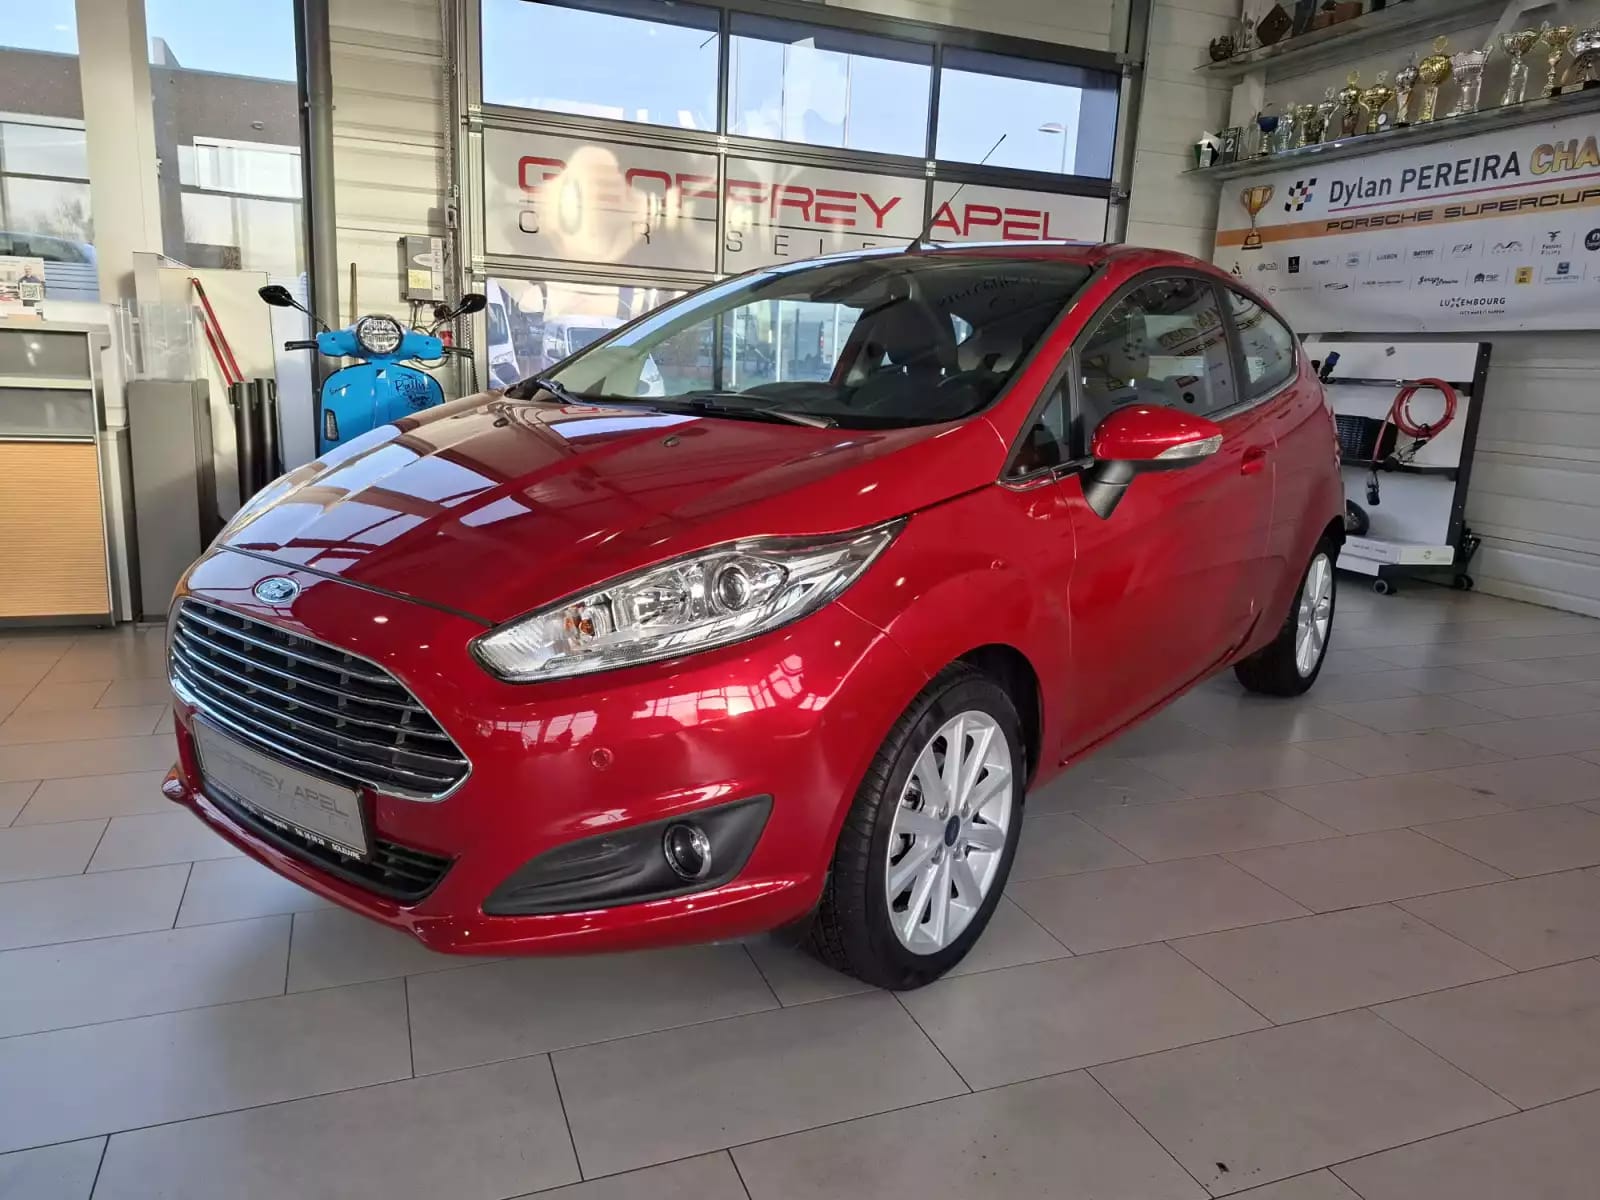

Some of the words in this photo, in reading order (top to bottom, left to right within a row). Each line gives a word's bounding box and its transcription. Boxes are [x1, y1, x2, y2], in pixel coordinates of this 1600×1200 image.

[1328, 174, 1392, 207] Dylan
[1400, 150, 1521, 194] PEREIRA
[1529, 134, 1600, 176] CHA
[1325, 209, 1434, 232] PORSCHE
[1439, 296, 1507, 308] LUXEMBOURG
